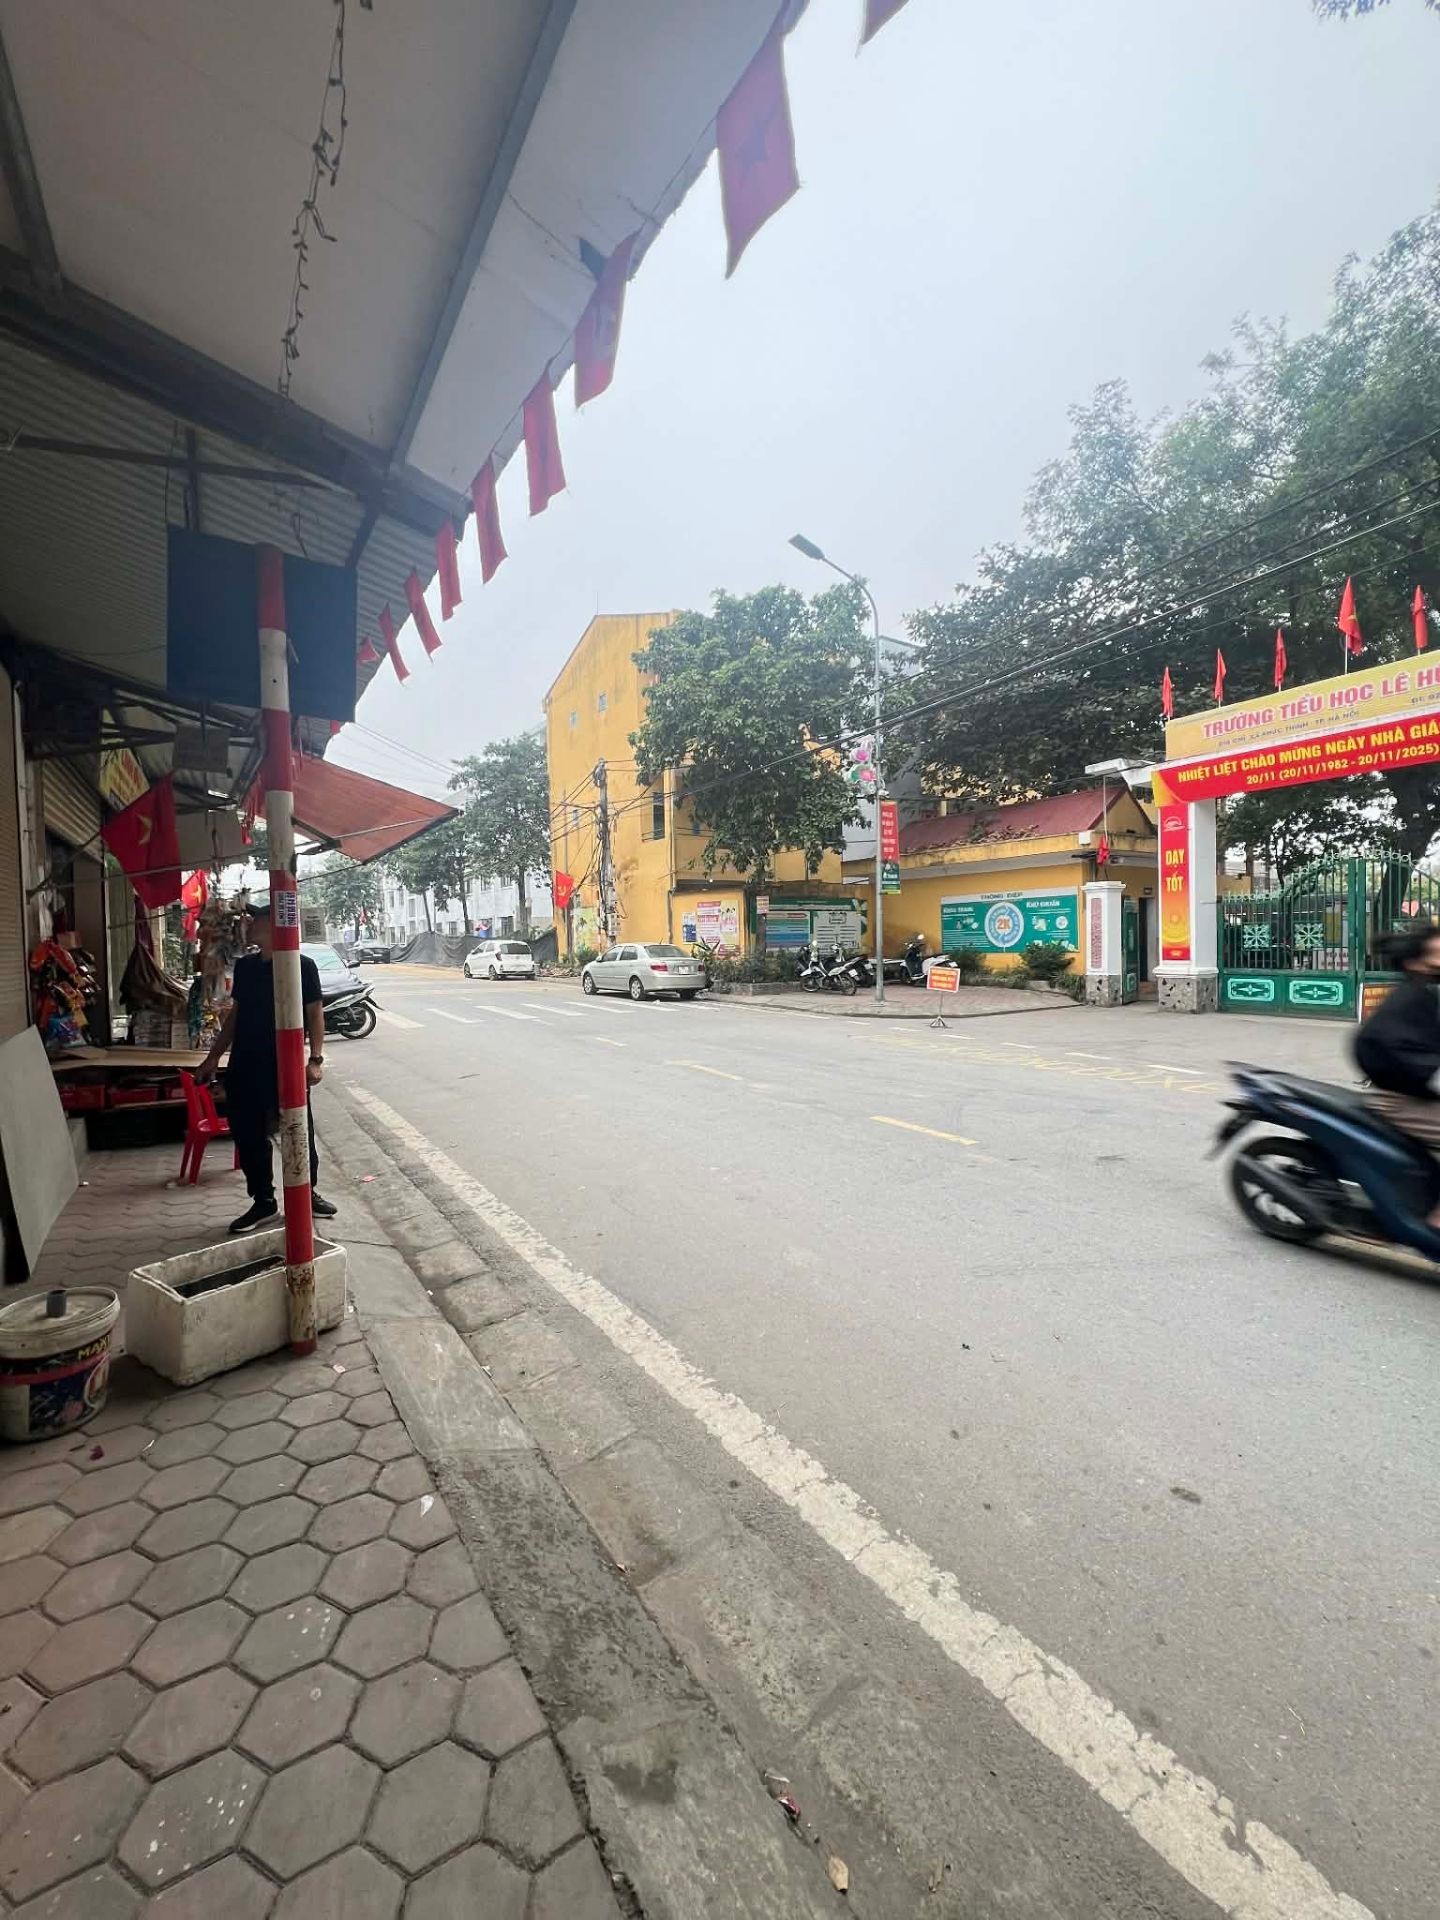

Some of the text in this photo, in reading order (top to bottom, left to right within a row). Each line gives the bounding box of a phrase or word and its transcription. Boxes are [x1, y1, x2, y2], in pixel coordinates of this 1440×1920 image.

[1204, 707, 1275, 739] TRƯỜNG
[1279, 694, 1323, 720] TIỂU
[1329, 684, 1375, 709] HỌC
[1381, 672, 1411, 697] LÊ
[1178, 766, 1210, 782] NHIỆT
[1213, 759, 1239, 776] LIỆT
[1241, 753, 1276, 772] CHÀO
[1279, 745, 1322, 765] MỪNG
[1326, 735, 1366, 755] NGÀY
[1371, 726, 1406, 746] NHÀ
[1246, 772, 1276, 785] 20/11
[1358, 743, 1440, 766] 20/11/2025)
[1165, 849, 1186, 868] DẠY
[1166, 871, 1185, 892] TỐT
